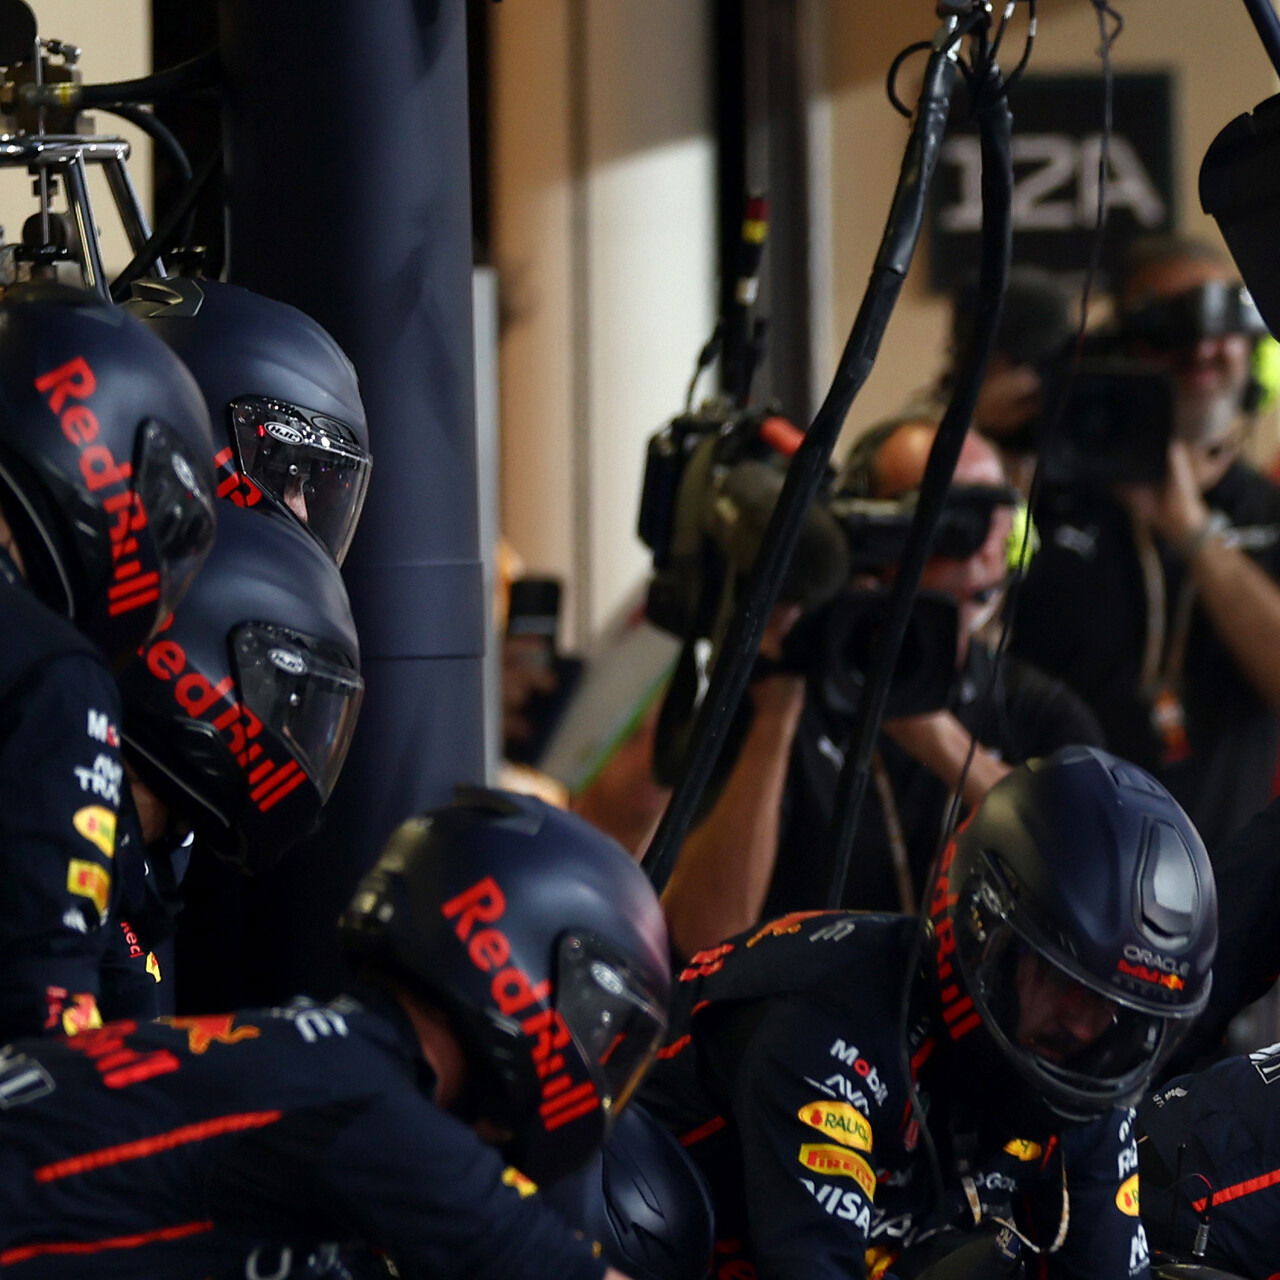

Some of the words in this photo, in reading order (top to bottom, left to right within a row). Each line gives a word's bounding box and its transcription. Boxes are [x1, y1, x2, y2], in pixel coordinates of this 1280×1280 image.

[940, 133, 1166, 232] 12A
[34, 356, 134, 491] Red
[138, 613, 235, 718] ed
[441, 876, 553, 1017] Red
[799, 1178, 871, 1239] VISA
